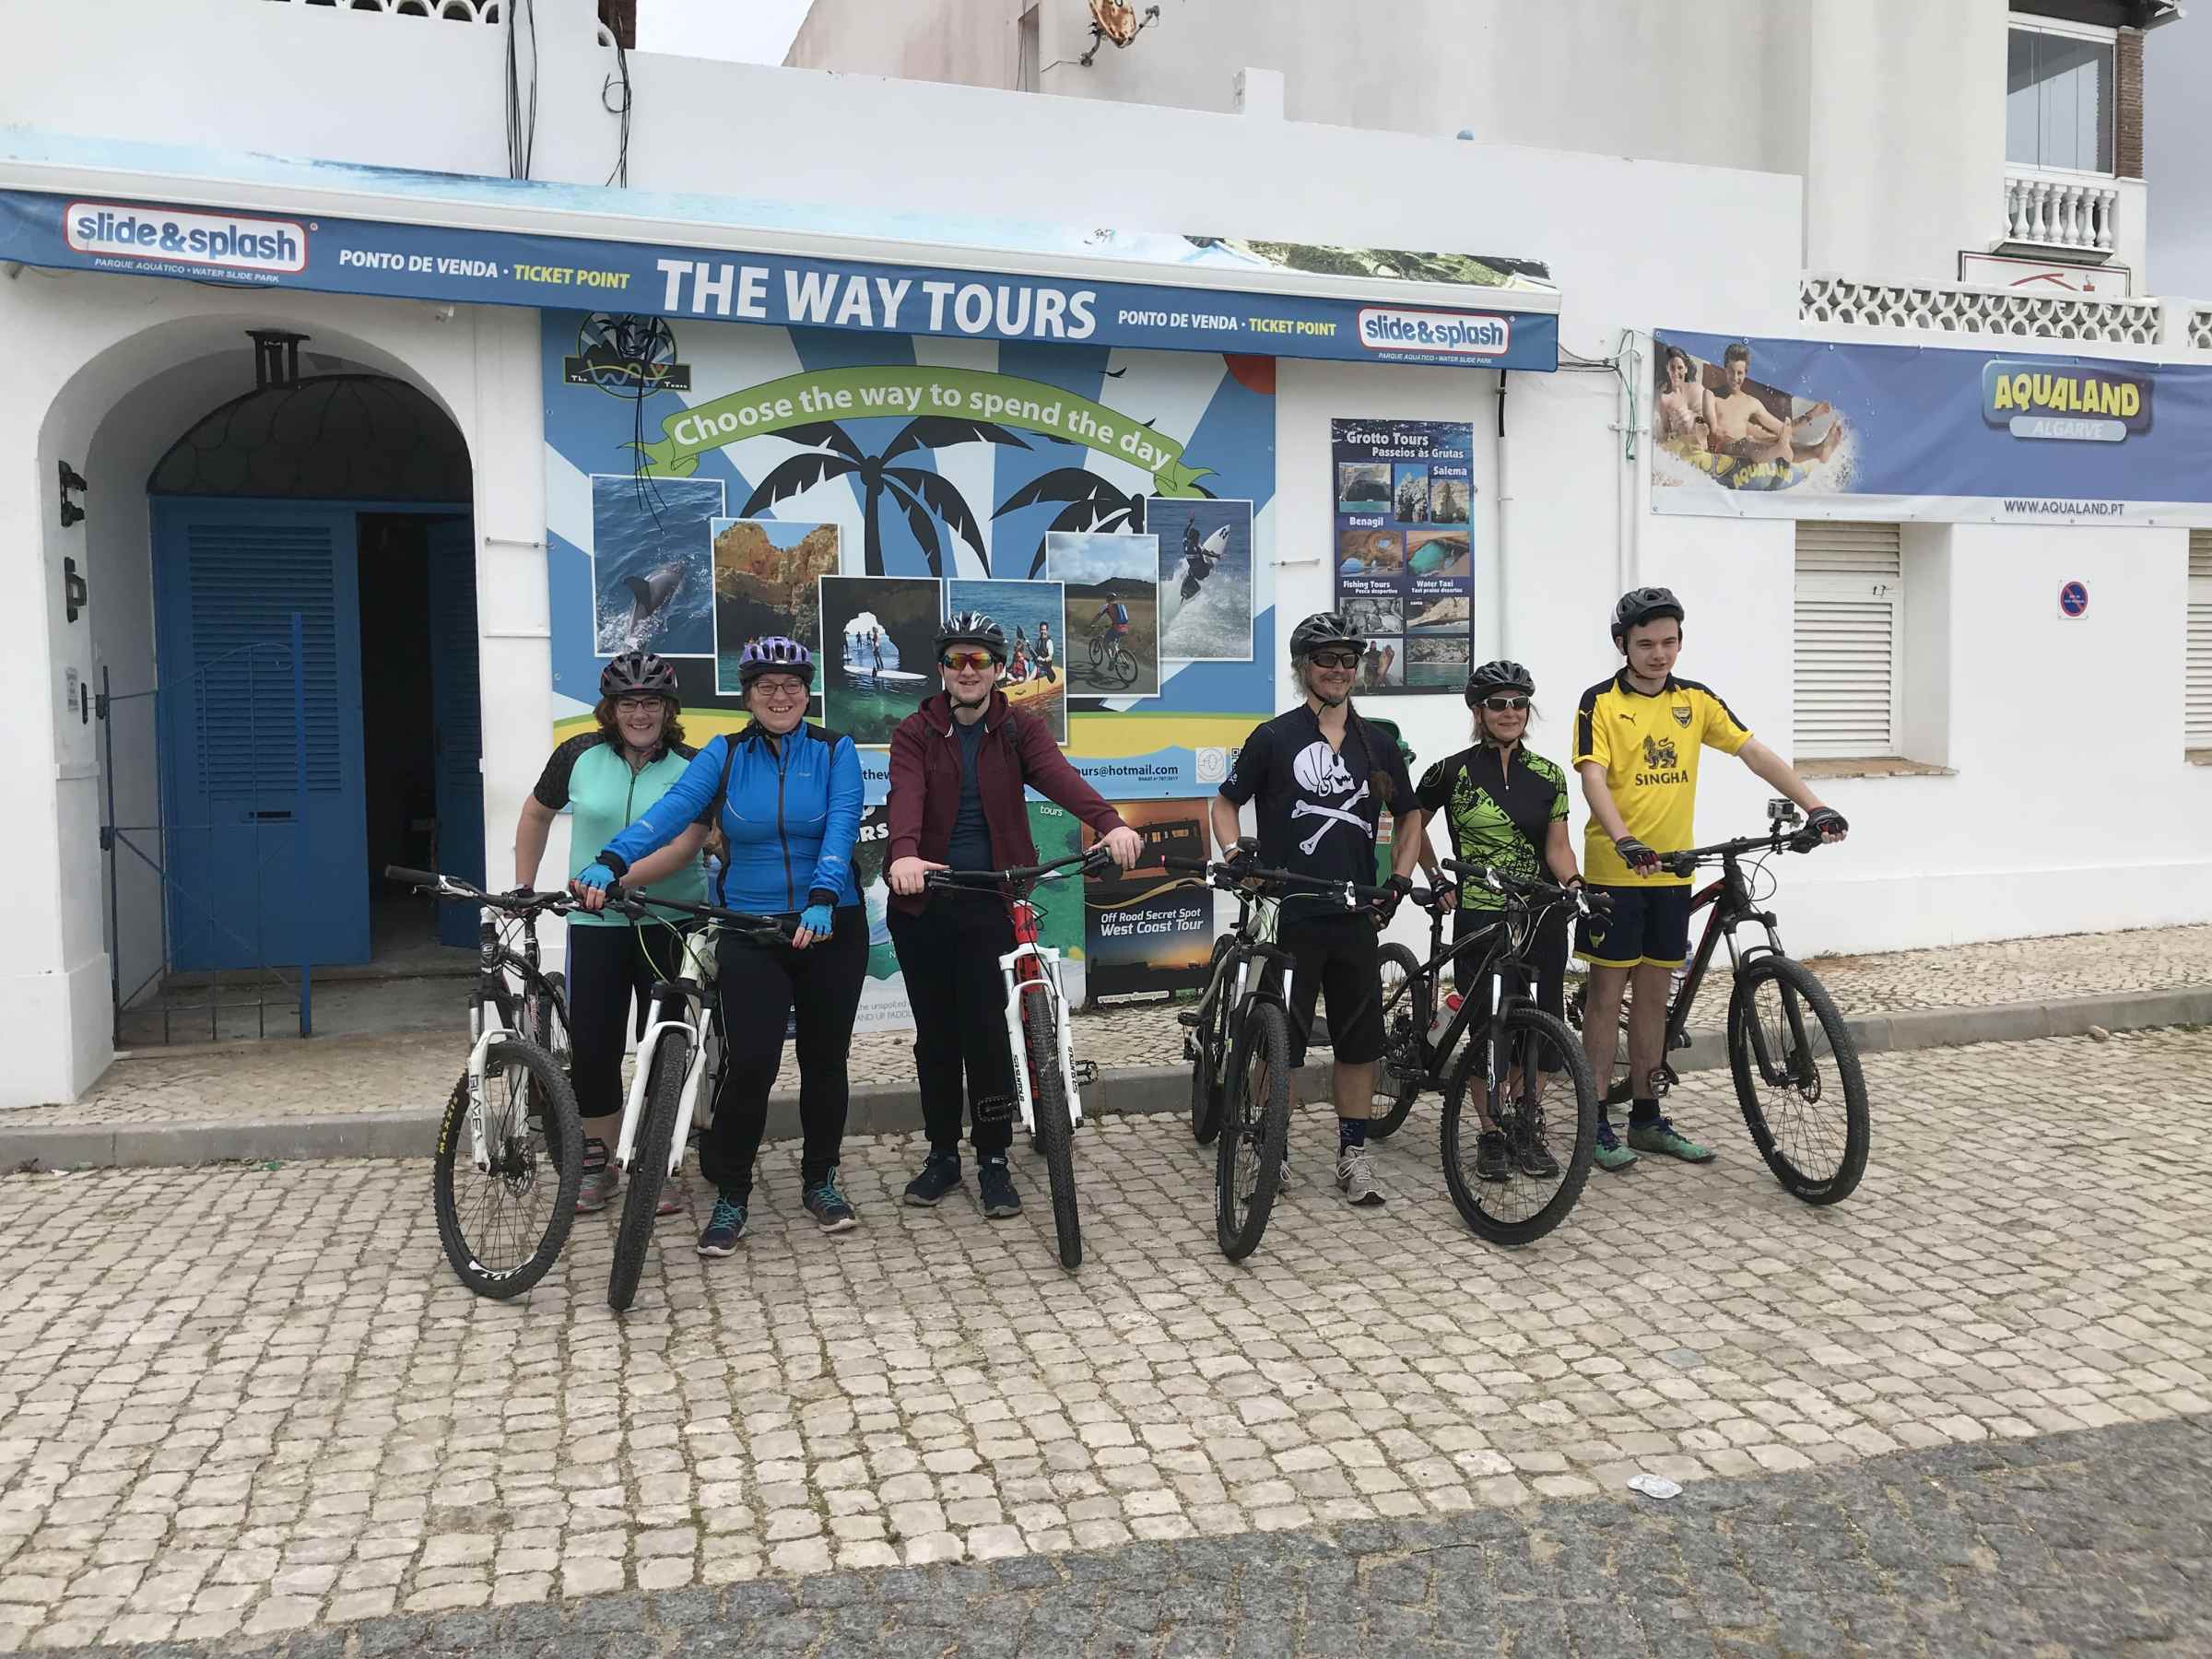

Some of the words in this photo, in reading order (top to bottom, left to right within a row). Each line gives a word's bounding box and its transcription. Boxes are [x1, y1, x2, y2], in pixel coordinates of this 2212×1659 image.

[76, 212, 297, 263] slide&splash
[94, 258, 134, 269] PARQUE
[135, 260, 184, 274] AQUÁTICO
[192, 266, 224, 277] WATER
[226, 270, 253, 280] SLIDE
[253, 273, 279, 282] PARK
[339, 249, 405, 274] PONTO
[409, 253, 432, 273] DE
[437, 254, 498, 278] VENDA
[513, 263, 573, 286] TICKET
[576, 266, 630, 290] POINT
[656, 258, 769, 318] THE
[783, 268, 913, 328] WAY
[922, 280, 1098, 339] TOURS
[1118, 310, 1168, 328] PONTO
[1171, 313, 1189, 329] DE
[1191, 314, 1238, 332] VENDA
[1248, 317, 1294, 335] TICKET
[1296, 320, 1336, 337] POINT
[1365, 314, 1504, 348] slide&splash
[1994, 372, 2140, 417] AQUALAND
[673, 396, 794, 446] Choose
[798, 384, 853, 414] the
[858, 386, 923, 412] way
[929, 382, 961, 407] to
[970, 390, 1062, 428] spend
[1067, 409, 1114, 445] the
[1120, 430, 1171, 472] day
[2031, 419, 2105, 438] ALGARVE
[1346, 430, 1389, 444] Grotto
[1393, 431, 1429, 446] Tours
[1372, 446, 1416, 458] Passeios
[1418, 448, 1430, 458] às
[1431, 449, 1464, 459] Grutas
[1433, 465, 1467, 477] Salema
[2004, 500, 2124, 516] WWW.AQUALAND.PT
[1349, 516, 1383, 528] Benagil
[1343, 581, 1369, 589] Fishing
[1635, 771, 1688, 785] SINGHA
[1040, 804, 1063, 818] tours
[1100, 912, 1117, 924] Off
[1119, 911, 1144, 923] Road
[1146, 909, 1177, 921] Secret
[1179, 907, 1202, 919] Spot
[1100, 923, 1133, 936] West
[1136, 921, 1172, 935] Coast
[1176, 919, 1204, 932] Tour
